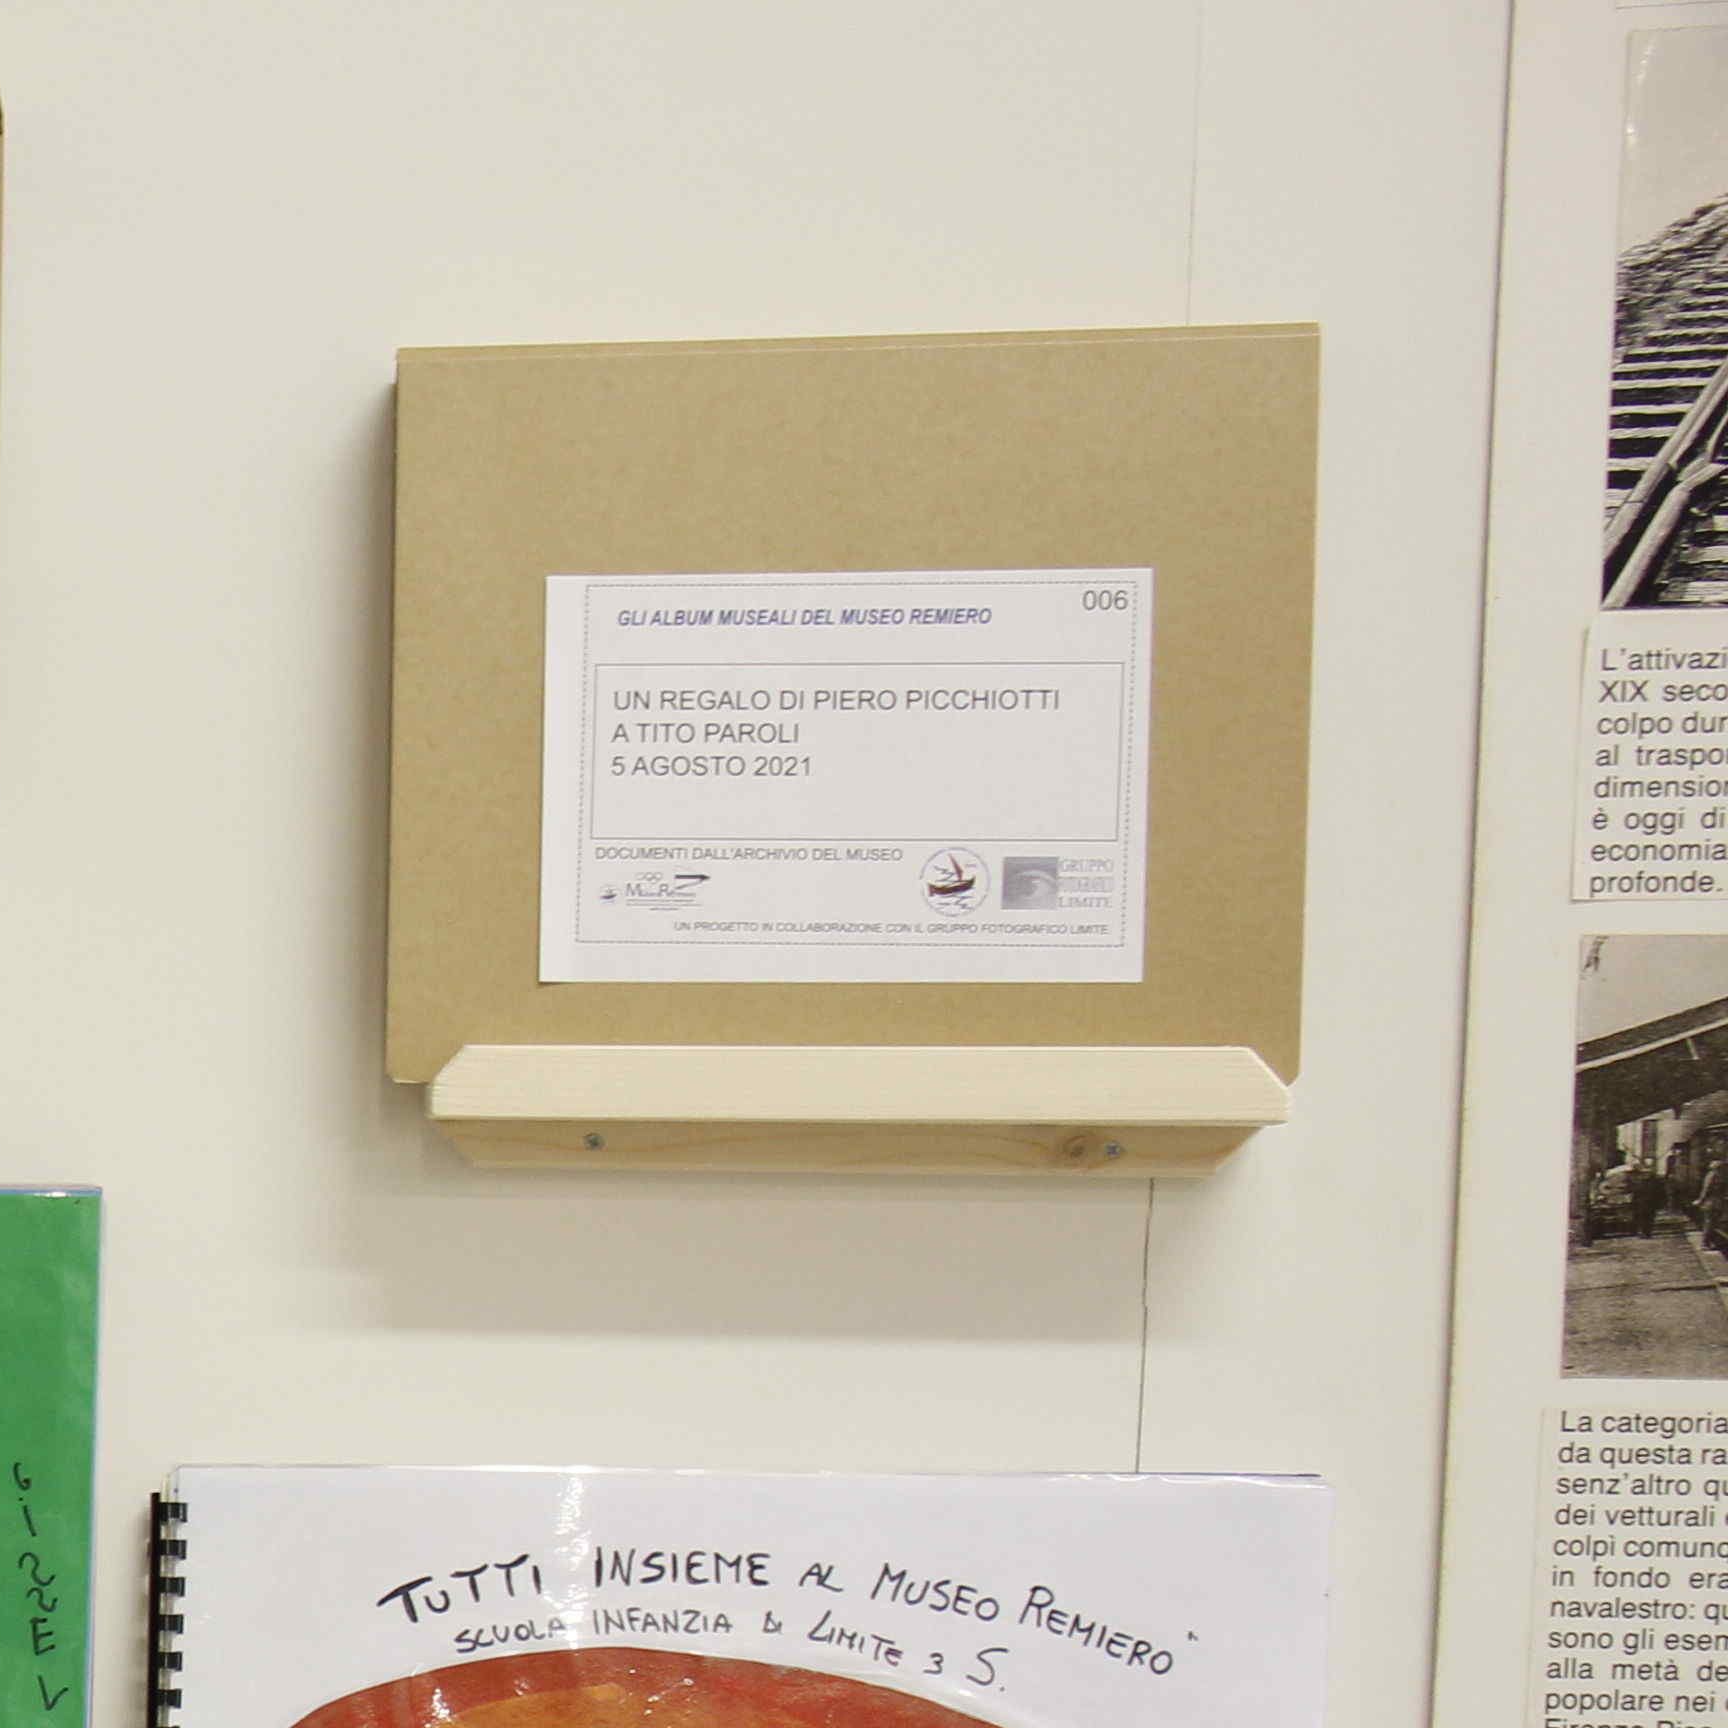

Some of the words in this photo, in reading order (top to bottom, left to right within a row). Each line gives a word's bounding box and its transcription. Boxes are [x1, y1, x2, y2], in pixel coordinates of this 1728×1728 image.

[1083, 590, 1128, 611] 006
[618, 610, 648, 626] GLI
[651, 609, 713, 626] ALBUM
[718, 608, 797, 625] MUSEALI
[801, 608, 834, 625] DEL
[841, 608, 904, 625] MUSEO
[910, 607, 992, 624] REMIERO
[614, 690, 651, 710] UN
[660, 690, 770, 711] REGALO
[780, 690, 805, 710] DI
[814, 689, 897, 711] PIERO
[906, 689, 1060, 710] PICCHIOTTI
[1599, 680, 1648, 702] XIX
[612, 723, 629, 744] A
[636, 723, 695, 744] TITO
[704, 723, 799, 744] PAROLI
[1597, 713, 1672, 739] colpo
[612, 756, 625, 776] 5
[632, 756, 745, 777] AGOSTO
[754, 756, 812, 776] 2021
[1596, 744, 1619, 766] al
[1593, 807, 1608, 830] è
[1624, 807, 1684, 835] oggi
[1701, 807, 1726, 829] di
[595, 847, 689, 861] DOCUMENTI
[693, 847, 807, 861] DALL'ARCHIVIO
[812, 847, 841, 861] DEL
[846, 847, 903, 861] MUSEO
[1591, 839, 1728, 861] economia
[1590, 871, 1723, 897] profonde.
[1560, 1411, 1594, 1433] La
[1601, 1412, 1728, 1438] categoria
[1558, 1442, 1591, 1464] da
[1600, 1444, 1692, 1468] questa
[1556, 1473, 1692, 1496] senz'altro
[1555, 1504, 1595, 1526] dei
[1605, 1505, 1714, 1527] vetturali
[1553, 1535, 1615, 1561] colpi
[377, 1552, 542, 1624] TUTTI
[595, 1547, 771, 1589] INSIEME
[799, 1562, 844, 1593] AL
[873, 1562, 999, 1624] MUSEO
[1551, 1565, 1574, 1587] in
[1594, 1566, 1670, 1589] fondo
[1550, 1597, 1694, 1621] navalestro:
[455, 1616, 566, 1654] SCUOLA
[594, 1609, 732, 1636] INFANZIA
[807, 1609, 903, 1667] LIMITE
[924, 1651, 943, 1675] 3
[1548, 1631, 1614, 1649] sono
[1623, 1629, 1654, 1655] gli
[1546, 1658, 1594, 1680] alla
[1612, 1660, 1680, 1681] metà
[1545, 1690, 1664, 1715] popolare
[1675, 1691, 1715, 1713] nei
